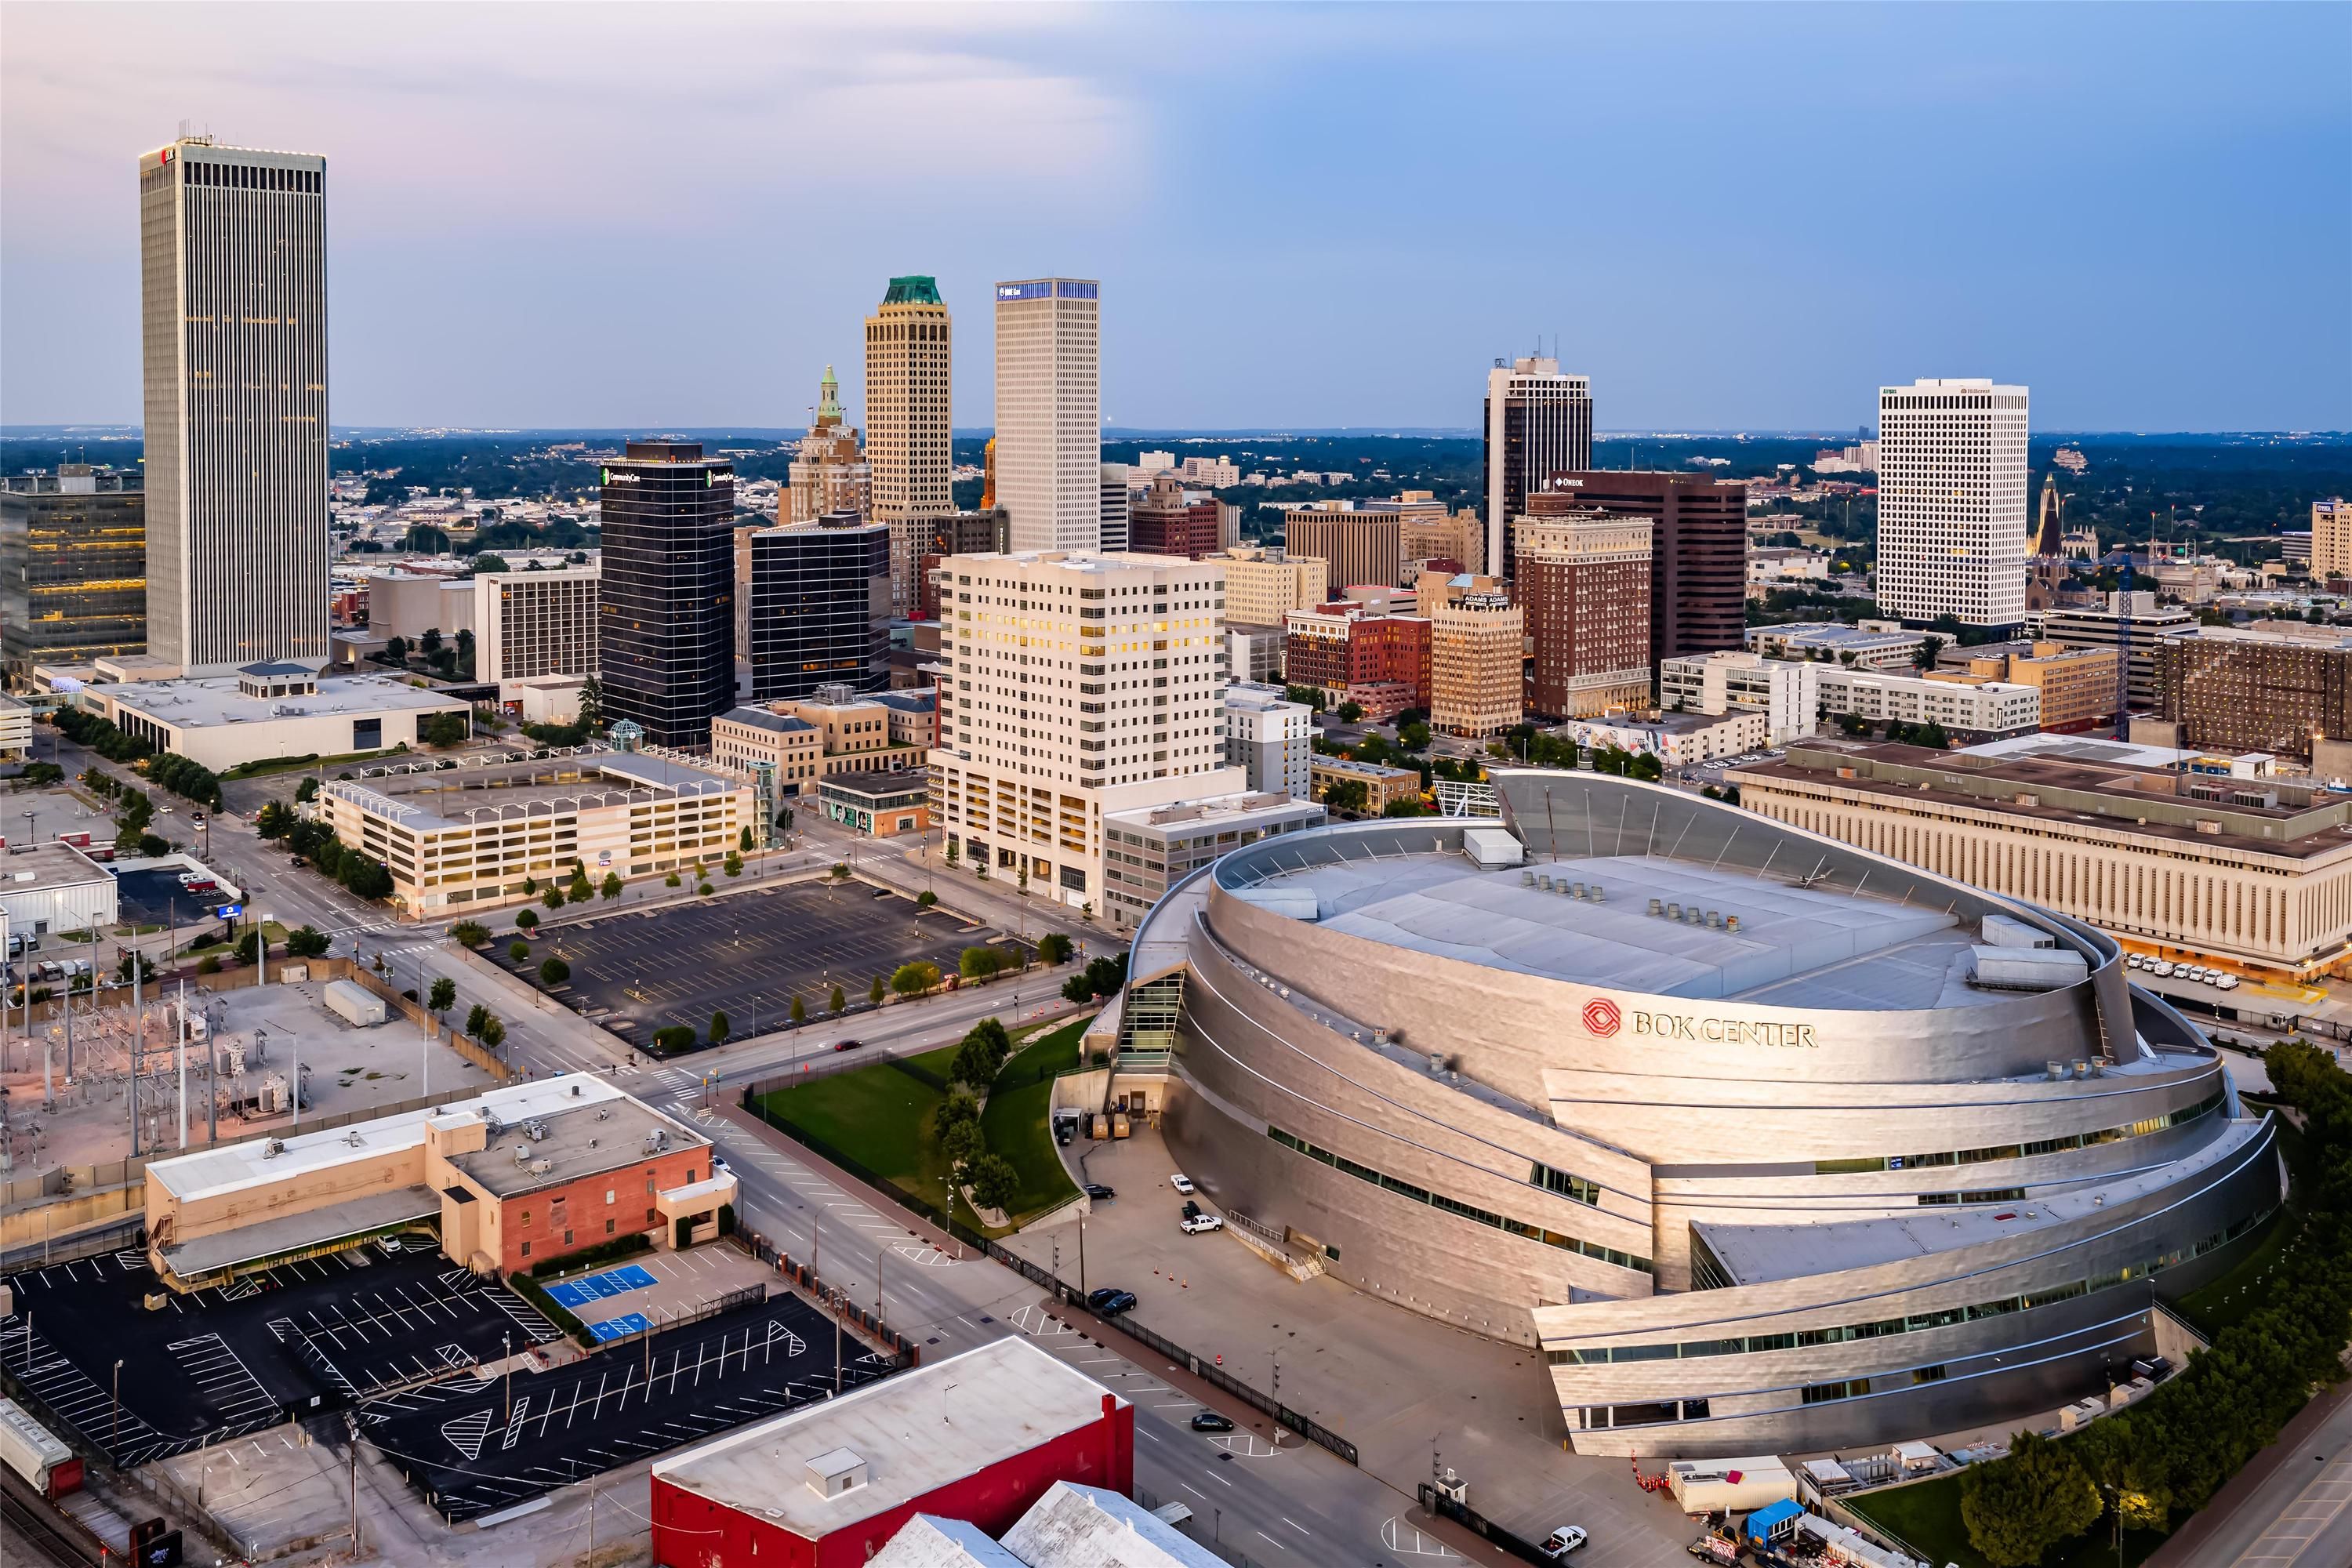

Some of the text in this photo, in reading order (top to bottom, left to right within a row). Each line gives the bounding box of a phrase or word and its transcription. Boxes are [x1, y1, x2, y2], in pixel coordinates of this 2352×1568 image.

[610, 473, 641, 483] CommunityCare
[712, 473, 734, 483] CommunityCare
[1632, 1011, 1819, 1047] BOK CENTER
